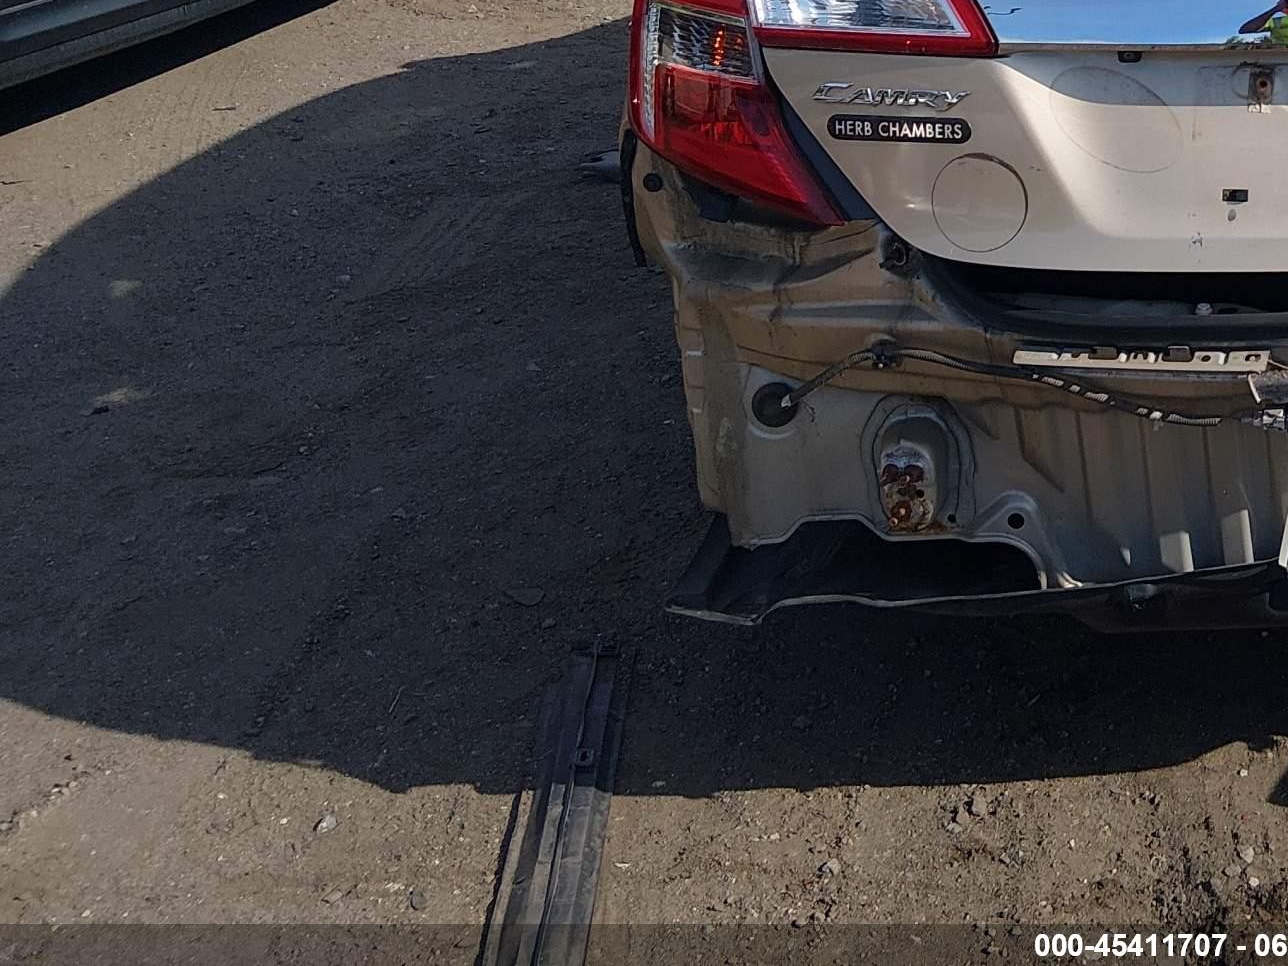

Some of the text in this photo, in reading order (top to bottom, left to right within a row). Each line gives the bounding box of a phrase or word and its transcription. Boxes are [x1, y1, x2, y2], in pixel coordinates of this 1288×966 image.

[812, 82, 971, 112] CAMRY
[835, 120, 963, 139] HERB CHAMBERS
